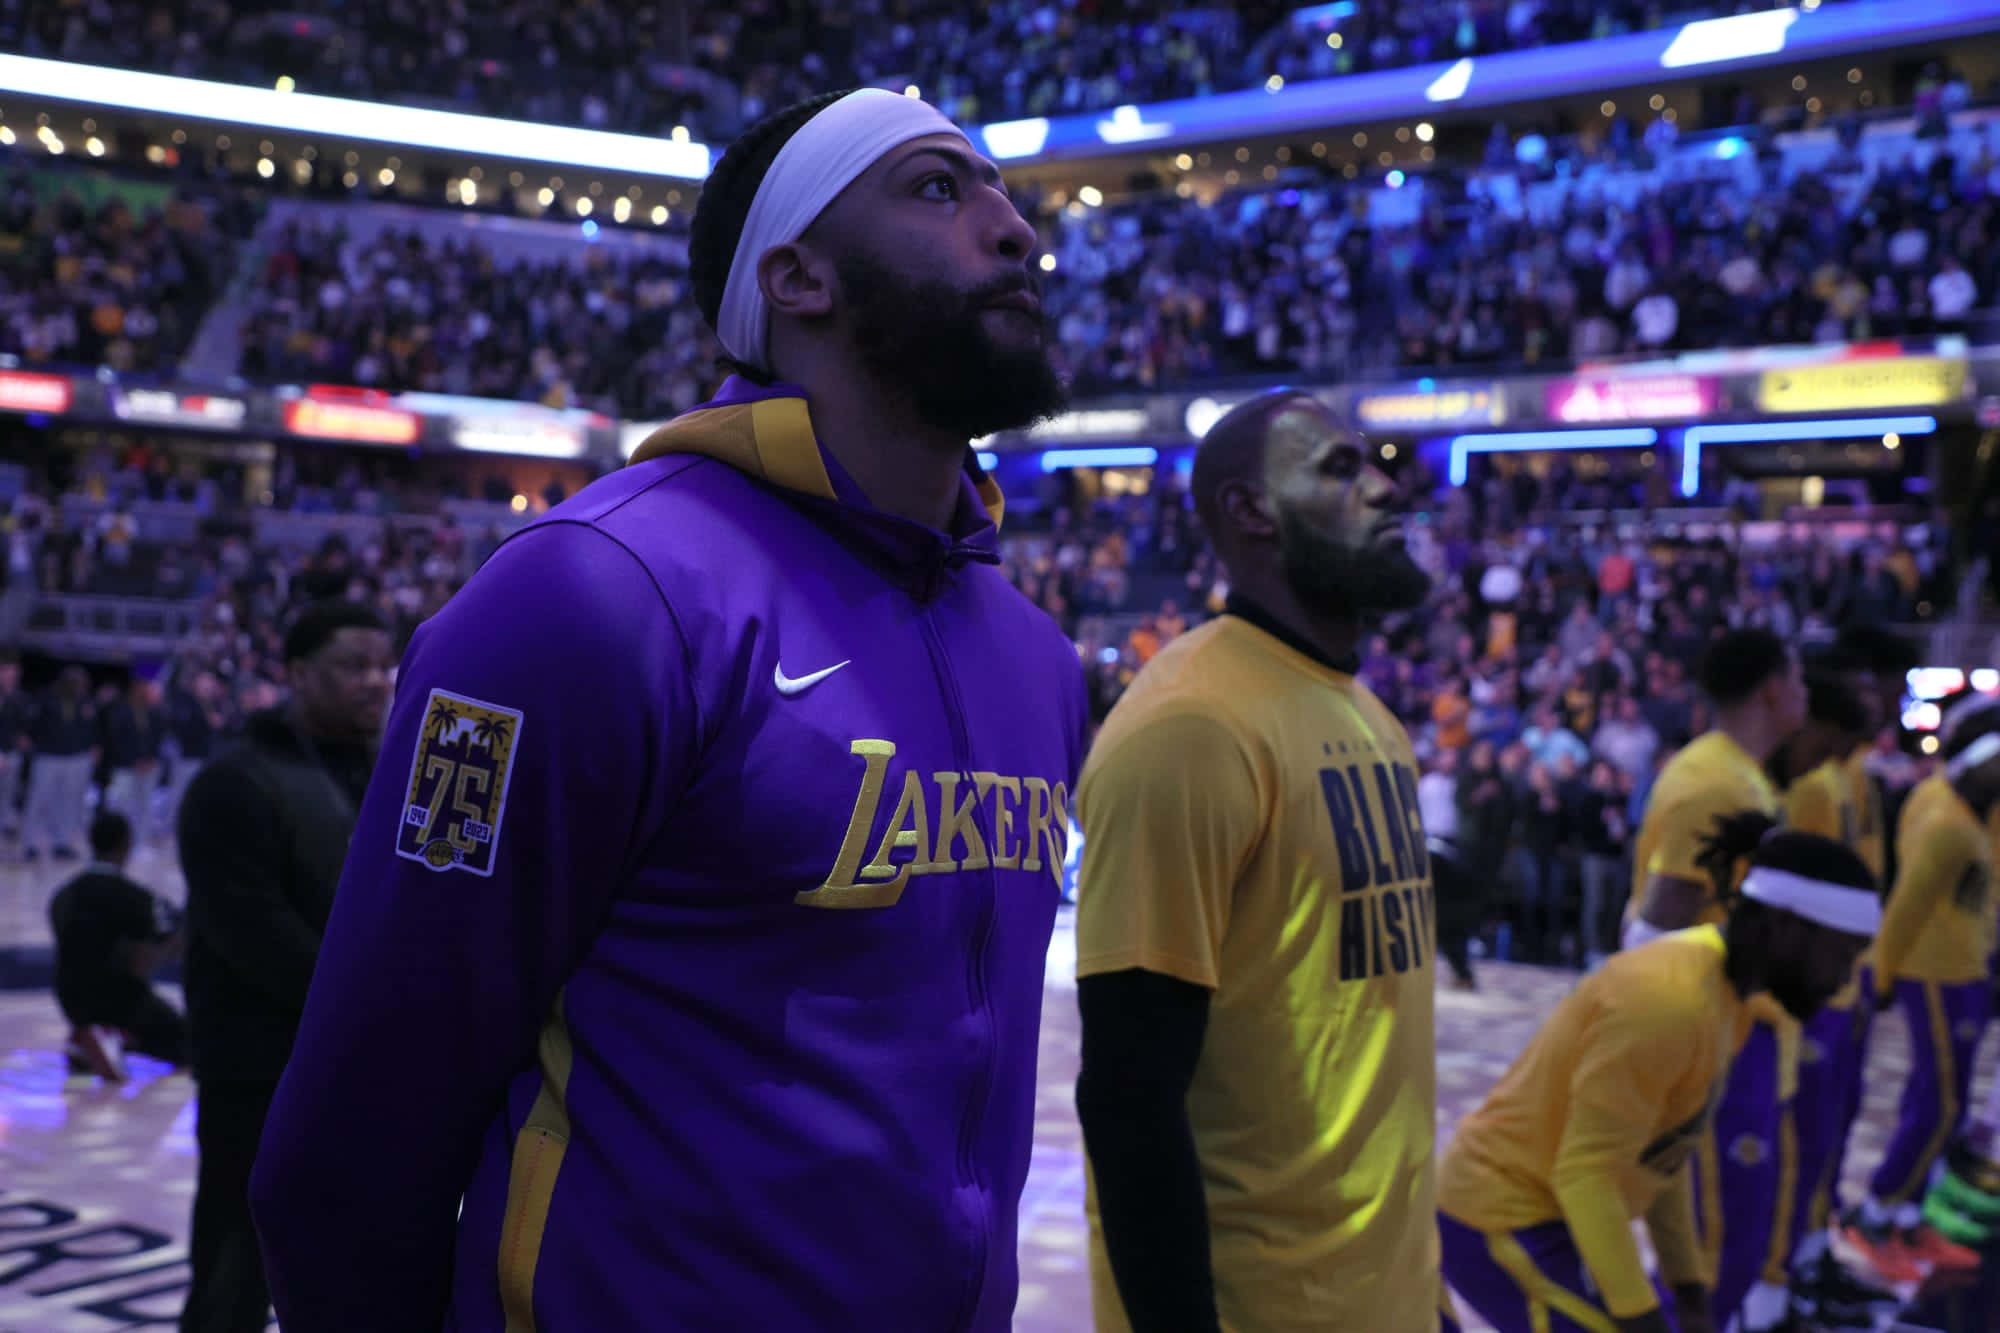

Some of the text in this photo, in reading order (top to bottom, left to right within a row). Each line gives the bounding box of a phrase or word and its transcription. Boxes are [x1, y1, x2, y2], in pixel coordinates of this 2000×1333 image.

[414, 754, 491, 854] 75
[464, 821, 490, 842] 2023
[794, 739, 1068, 909] LAKERS
